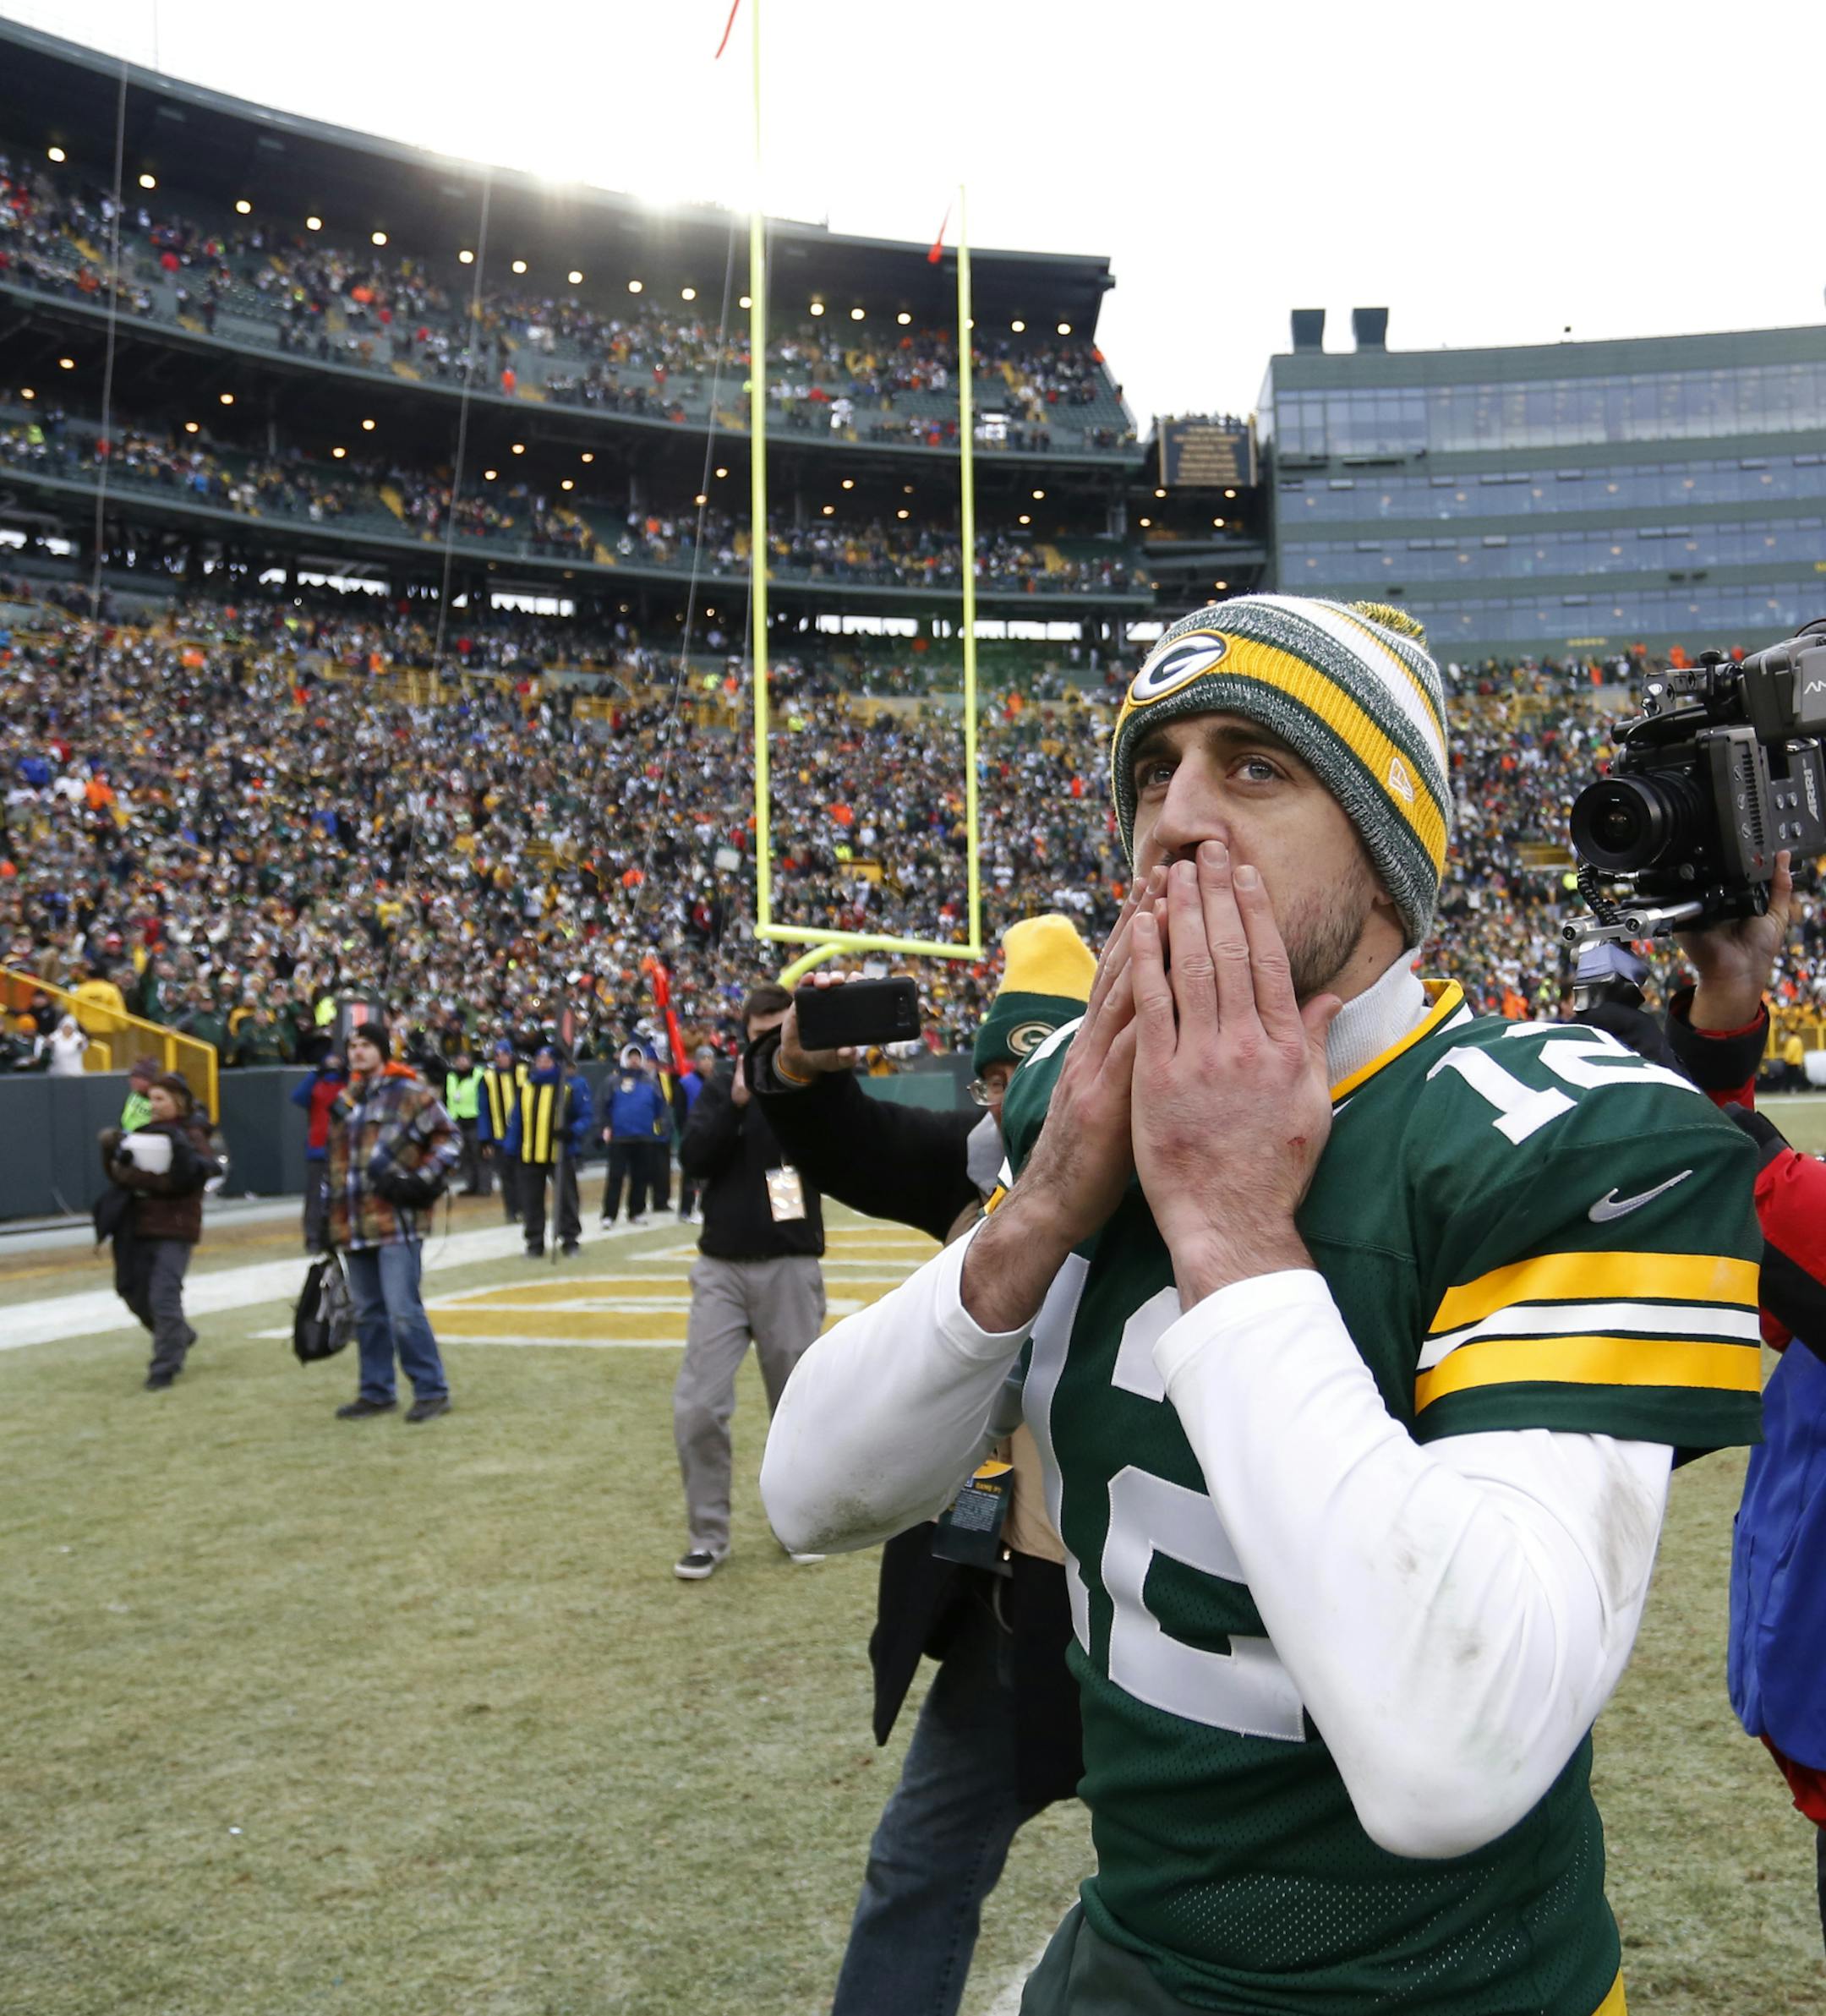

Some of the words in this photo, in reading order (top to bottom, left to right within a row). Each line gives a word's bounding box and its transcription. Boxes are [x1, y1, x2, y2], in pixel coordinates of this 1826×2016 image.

[1133, 636, 1222, 700] G
[1803, 768, 1819, 822] ARRI
[1427, 1021, 1701, 1145] 12
[1022, 1253, 1305, 1742] 12
